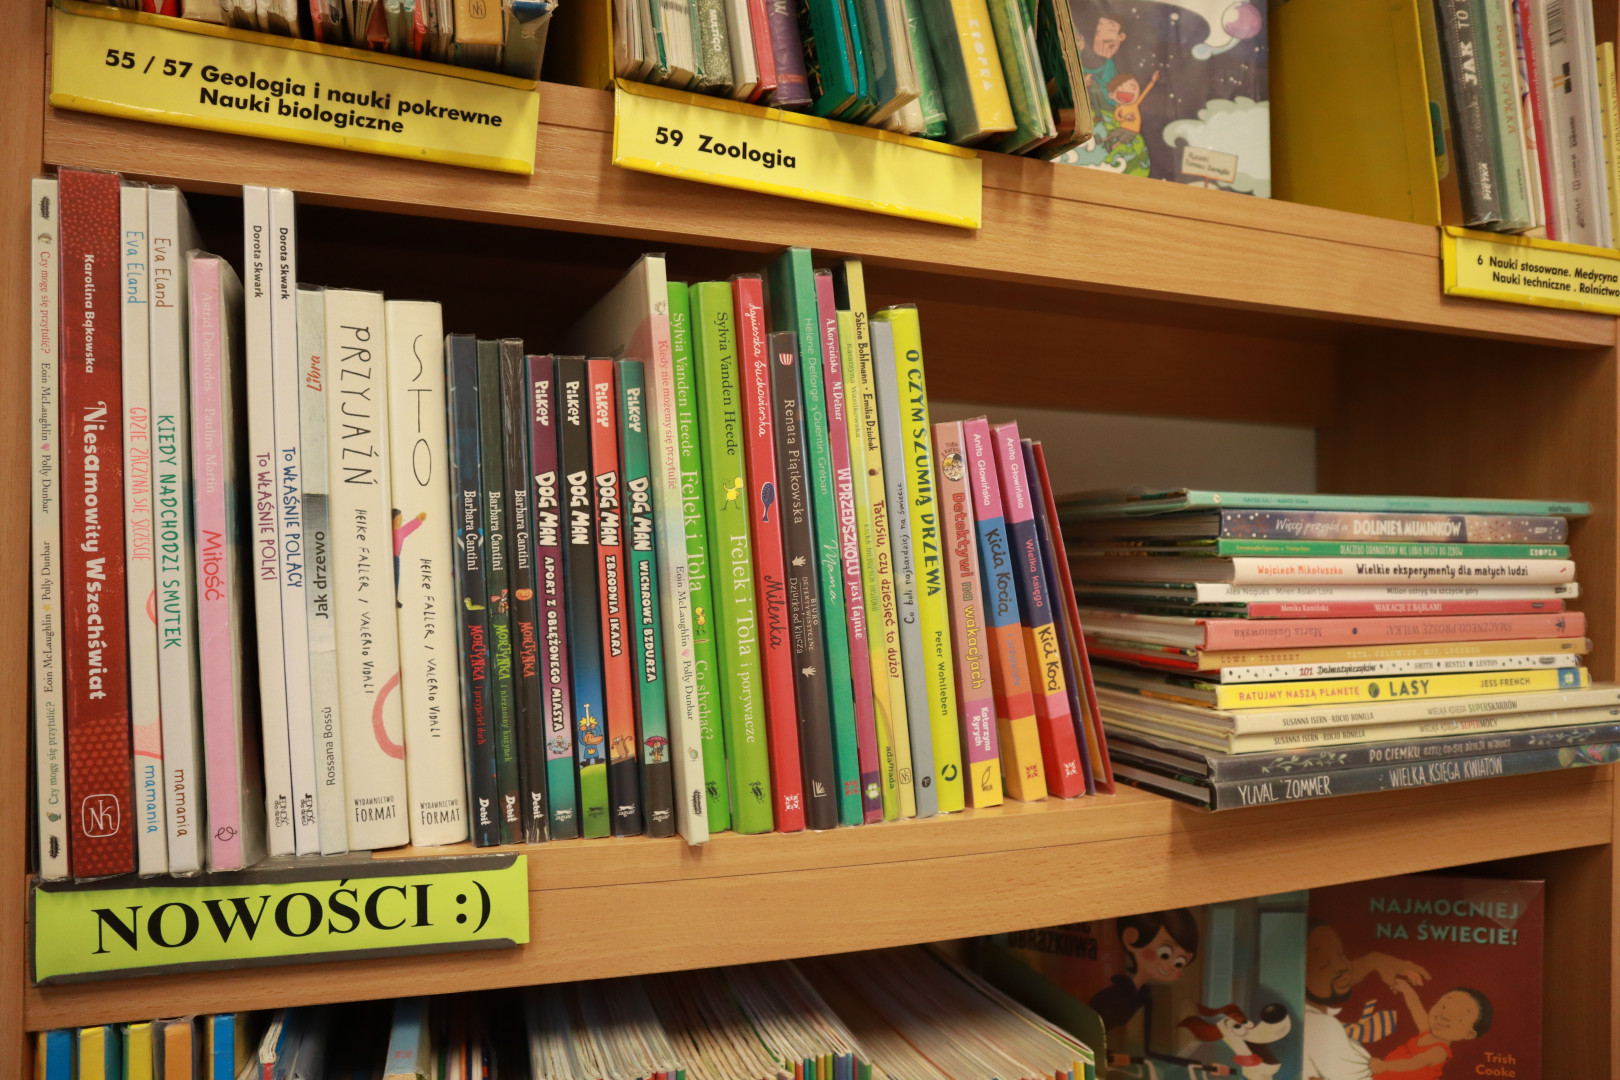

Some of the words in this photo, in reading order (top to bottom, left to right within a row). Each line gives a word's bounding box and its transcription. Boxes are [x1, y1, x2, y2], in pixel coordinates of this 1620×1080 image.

[104, 47, 136, 70] 55
[162, 58, 193, 79] 57
[200, 65, 307, 98] Geologia
[313, 81, 321, 98] i
[327, 85, 391, 110] nauki
[397, 97, 503, 128] pokrewne
[199, 87, 270, 115] Nauki
[278, 98, 404, 135] biologiczne
[655, 127, 683, 146] 59
[698, 134, 797, 169] Zoologia
[126, 230, 144, 256] Eva
[154, 238, 171, 262] Eva
[252, 225, 263, 259] Dorota
[279, 227, 289, 261] Dorota
[84, 254, 95, 308] Karolina
[127, 262, 147, 304] Eland
[155, 268, 174, 308] Eland
[253, 262, 263, 298] Skwark
[280, 264, 290, 300] Skwark
[1477, 255, 1483, 265] 6
[1490, 256, 1518, 270] Nauki
[1520, 261, 1571, 277] stosowane.
[1575, 268, 1618, 284] Medycyna
[1492, 271, 1520, 285] Nauki
[1524, 276, 1571, 291] techniczne
[1580, 283, 1620, 297] Rolnictwo
[82, 311, 95, 373] Bąkowska
[714, 312, 728, 351] Sylvia
[855, 311, 866, 340] Sabine
[658, 340, 670, 368] Kiedy
[857, 342, 870, 384] Bohlmann
[661, 372, 670, 387] nie
[676, 356, 690, 406] Vanden
[721, 355, 735, 406] Vanden
[340, 325, 379, 485] PRZYJAŹŃ
[662, 388, 674, 428] możemy
[784, 399, 797, 444] Renata
[807, 357, 819, 402] Delforge
[814, 412, 824, 454] Quentin
[863, 393, 874, 420] Emilia
[157, 416, 176, 465] KIEDY
[664, 430, 675, 445] się
[680, 412, 693, 456] Heede
[725, 411, 738, 456] Heede
[866, 421, 878, 451] Dziubak
[972, 433, 982, 457] Anita
[1006, 437, 1016, 461] Anita
[81, 400, 107, 552] Niesamowity
[665, 447, 677, 490] przytulić
[787, 449, 804, 524] Piątkowska
[908, 369, 925, 422] CZYM
[920, 513, 941, 597] DRZEWA
[42, 479, 51, 513] Dunbar
[464, 490, 476, 531] Barbara
[489, 491, 501, 531] Barbara
[515, 490, 527, 529] Barbara
[159, 474, 179, 572] NADCHODZI
[873, 500, 885, 548] Tatusiu,
[202, 530, 224, 601] Miłość
[313, 531, 327, 590] drzewo
[466, 534, 479, 571] Cantini
[491, 534, 503, 571] Cantini
[517, 532, 529, 569] Cantini
[730, 535, 751, 590] Felek
[838, 484, 859, 575] PRZEDSZKOLU
[851, 605, 864, 640] fajnie
[878, 553, 888, 574] czy
[544, 556, 555, 595] APORT
[605, 555, 618, 614] ZBRODNIA
[676, 566, 685, 588] Eoin
[1025, 539, 1037, 573] Wielka
[1031, 575, 1044, 608] księga
[1257, 564, 1295, 576] Wojciech
[1298, 565, 1343, 575] Mikołuszko
[1356, 563, 1391, 575] Wielkie
[1393, 564, 1455, 579] eksperymenty
[1458, 564, 1471, 576] dla
[1475, 566, 1506, 579] małych
[1508, 566, 1528, 576] ludzi
[640, 560, 653, 625] WICHROWE
[789, 577, 800, 611] Dziurka
[881, 579, 895, 627] dziesięć
[961, 582, 973, 601] na
[87, 557, 107, 700] Wszechświat
[163, 580, 182, 649] SMUTEK
[678, 591, 689, 647] McLaughlin
[810, 599, 818, 625] BIURO
[546, 611, 562, 684] OBLĘŻONEGO
[609, 618, 622, 656] IKARA
[736, 610, 755, 656] Tola
[794, 625, 804, 654] klucza
[887, 631, 896, 643] to
[934, 631, 943, 658] Peter
[964, 605, 985, 689] wakacjach
[644, 628, 657, 683] BZDURZA
[682, 661, 691, 683] Polly
[889, 647, 899, 678] dużo?
[1300, 667, 1313, 676] 101
[685, 686, 693, 721] Dunbar
[737, 672, 755, 743] porywacze
[937, 662, 949, 716] Wohlleben
[1238, 691, 1282, 701] RATUJMY
[1286, 689, 1317, 699] NASZĄ
[1319, 686, 1360, 697] PLANETĘ
[1389, 679, 1430, 697] LASY
[1481, 679, 1498, 688] JESS
[1500, 677, 1531, 687] FRENCH
[550, 688, 564, 732] MIASTA
[980, 707, 992, 751] Katarzyna
[972, 716, 983, 747] Ryrych
[325, 741, 335, 785] Rossana
[1369, 750, 1382, 762] PO
[1385, 746, 1420, 760] CIEMKU
[145, 765, 160, 833] mamania
[1237, 785, 1279, 806] YUVAL
[1284, 775, 1332, 799] ZOMMER
[1389, 764, 1426, 788] WIELKA
[1429, 761, 1461, 782] KSIĘGA
[1464, 756, 1503, 779] KWIATÓW
[479, 798, 491, 825] Debit
[505, 795, 520, 823] Debit
[531, 792, 543, 819] Debit
[91, 878, 434, 956] NOWOŚCI
[1368, 896, 1521, 922] NAJMOCNIEJ
[1375, 921, 1409, 942] NA
[1416, 918, 1520, 947] ŚWIECIE!
[1474, 1063, 1517, 1079] Cooke
[1483, 1051, 1517, 1066] Trish
